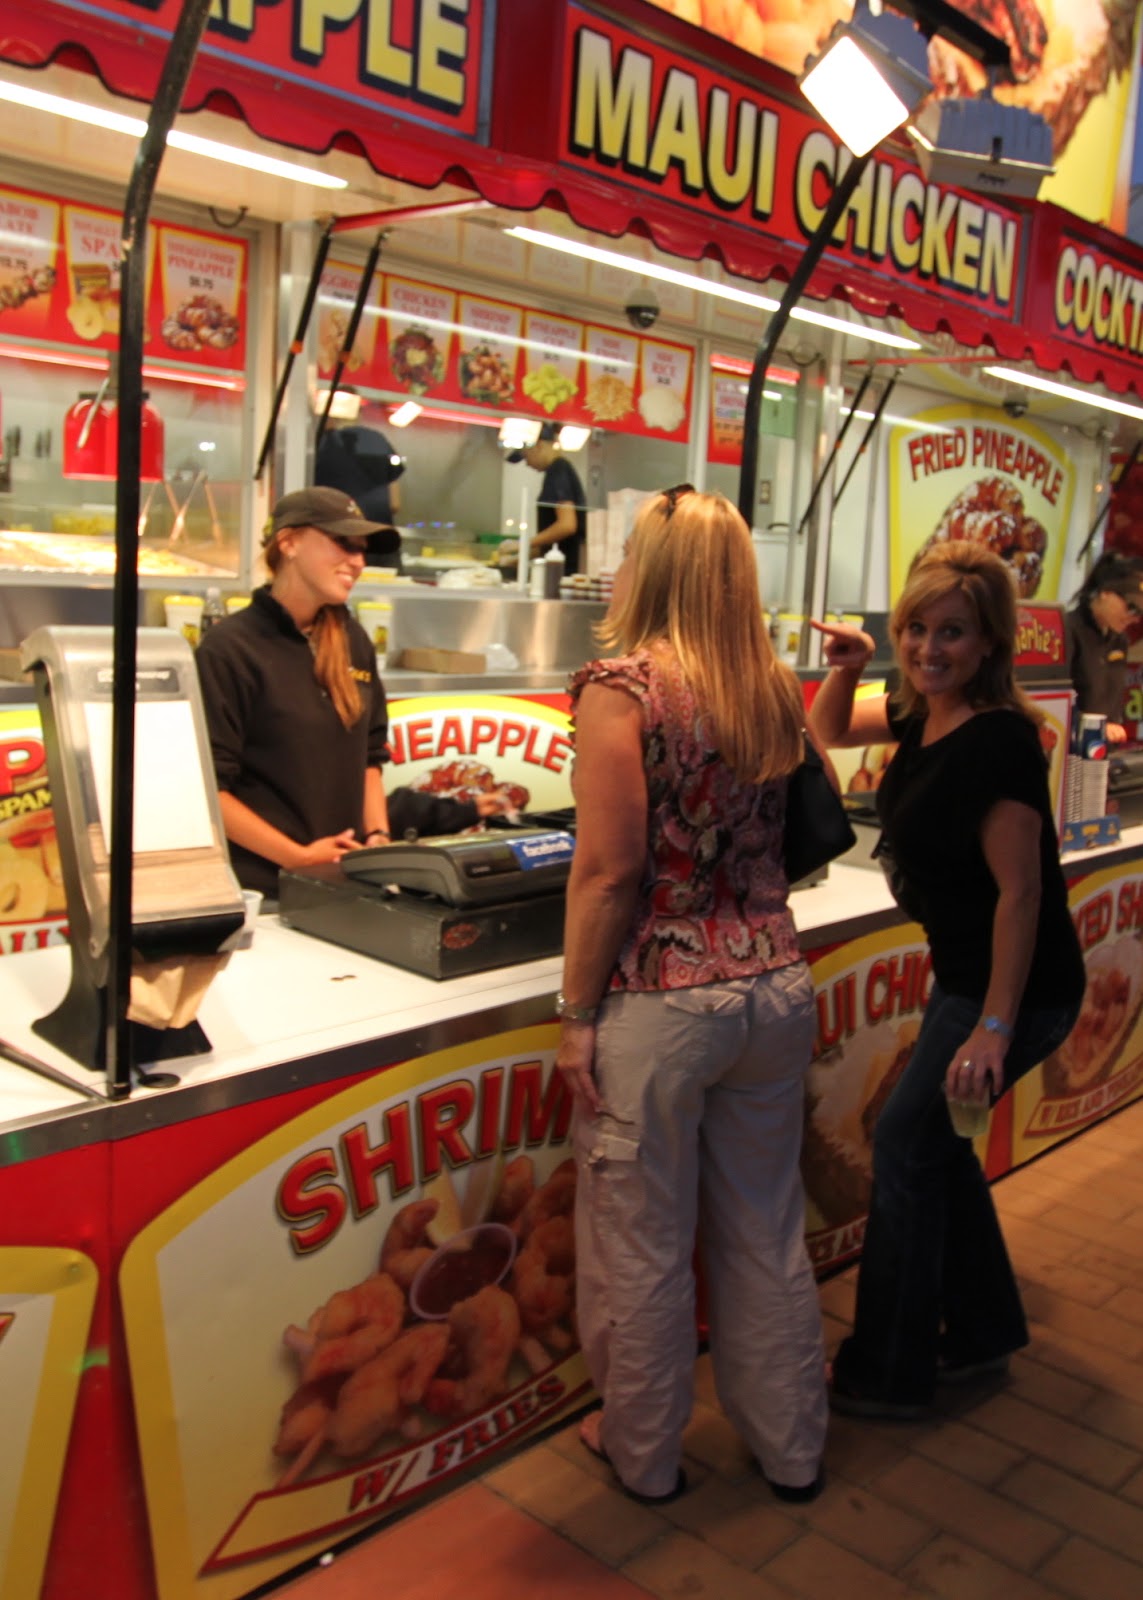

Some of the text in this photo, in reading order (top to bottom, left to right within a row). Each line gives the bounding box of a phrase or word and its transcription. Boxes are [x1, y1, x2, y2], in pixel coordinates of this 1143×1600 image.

[570, 28, 1017, 307] MAUI CHICKEN
[1055, 246, 1143, 356] COCKT
[908, 426, 1064, 507] FRIED PINEAPPLE
[811, 971, 857, 1056] UI
[427, 1374, 566, 1477] FRIES
